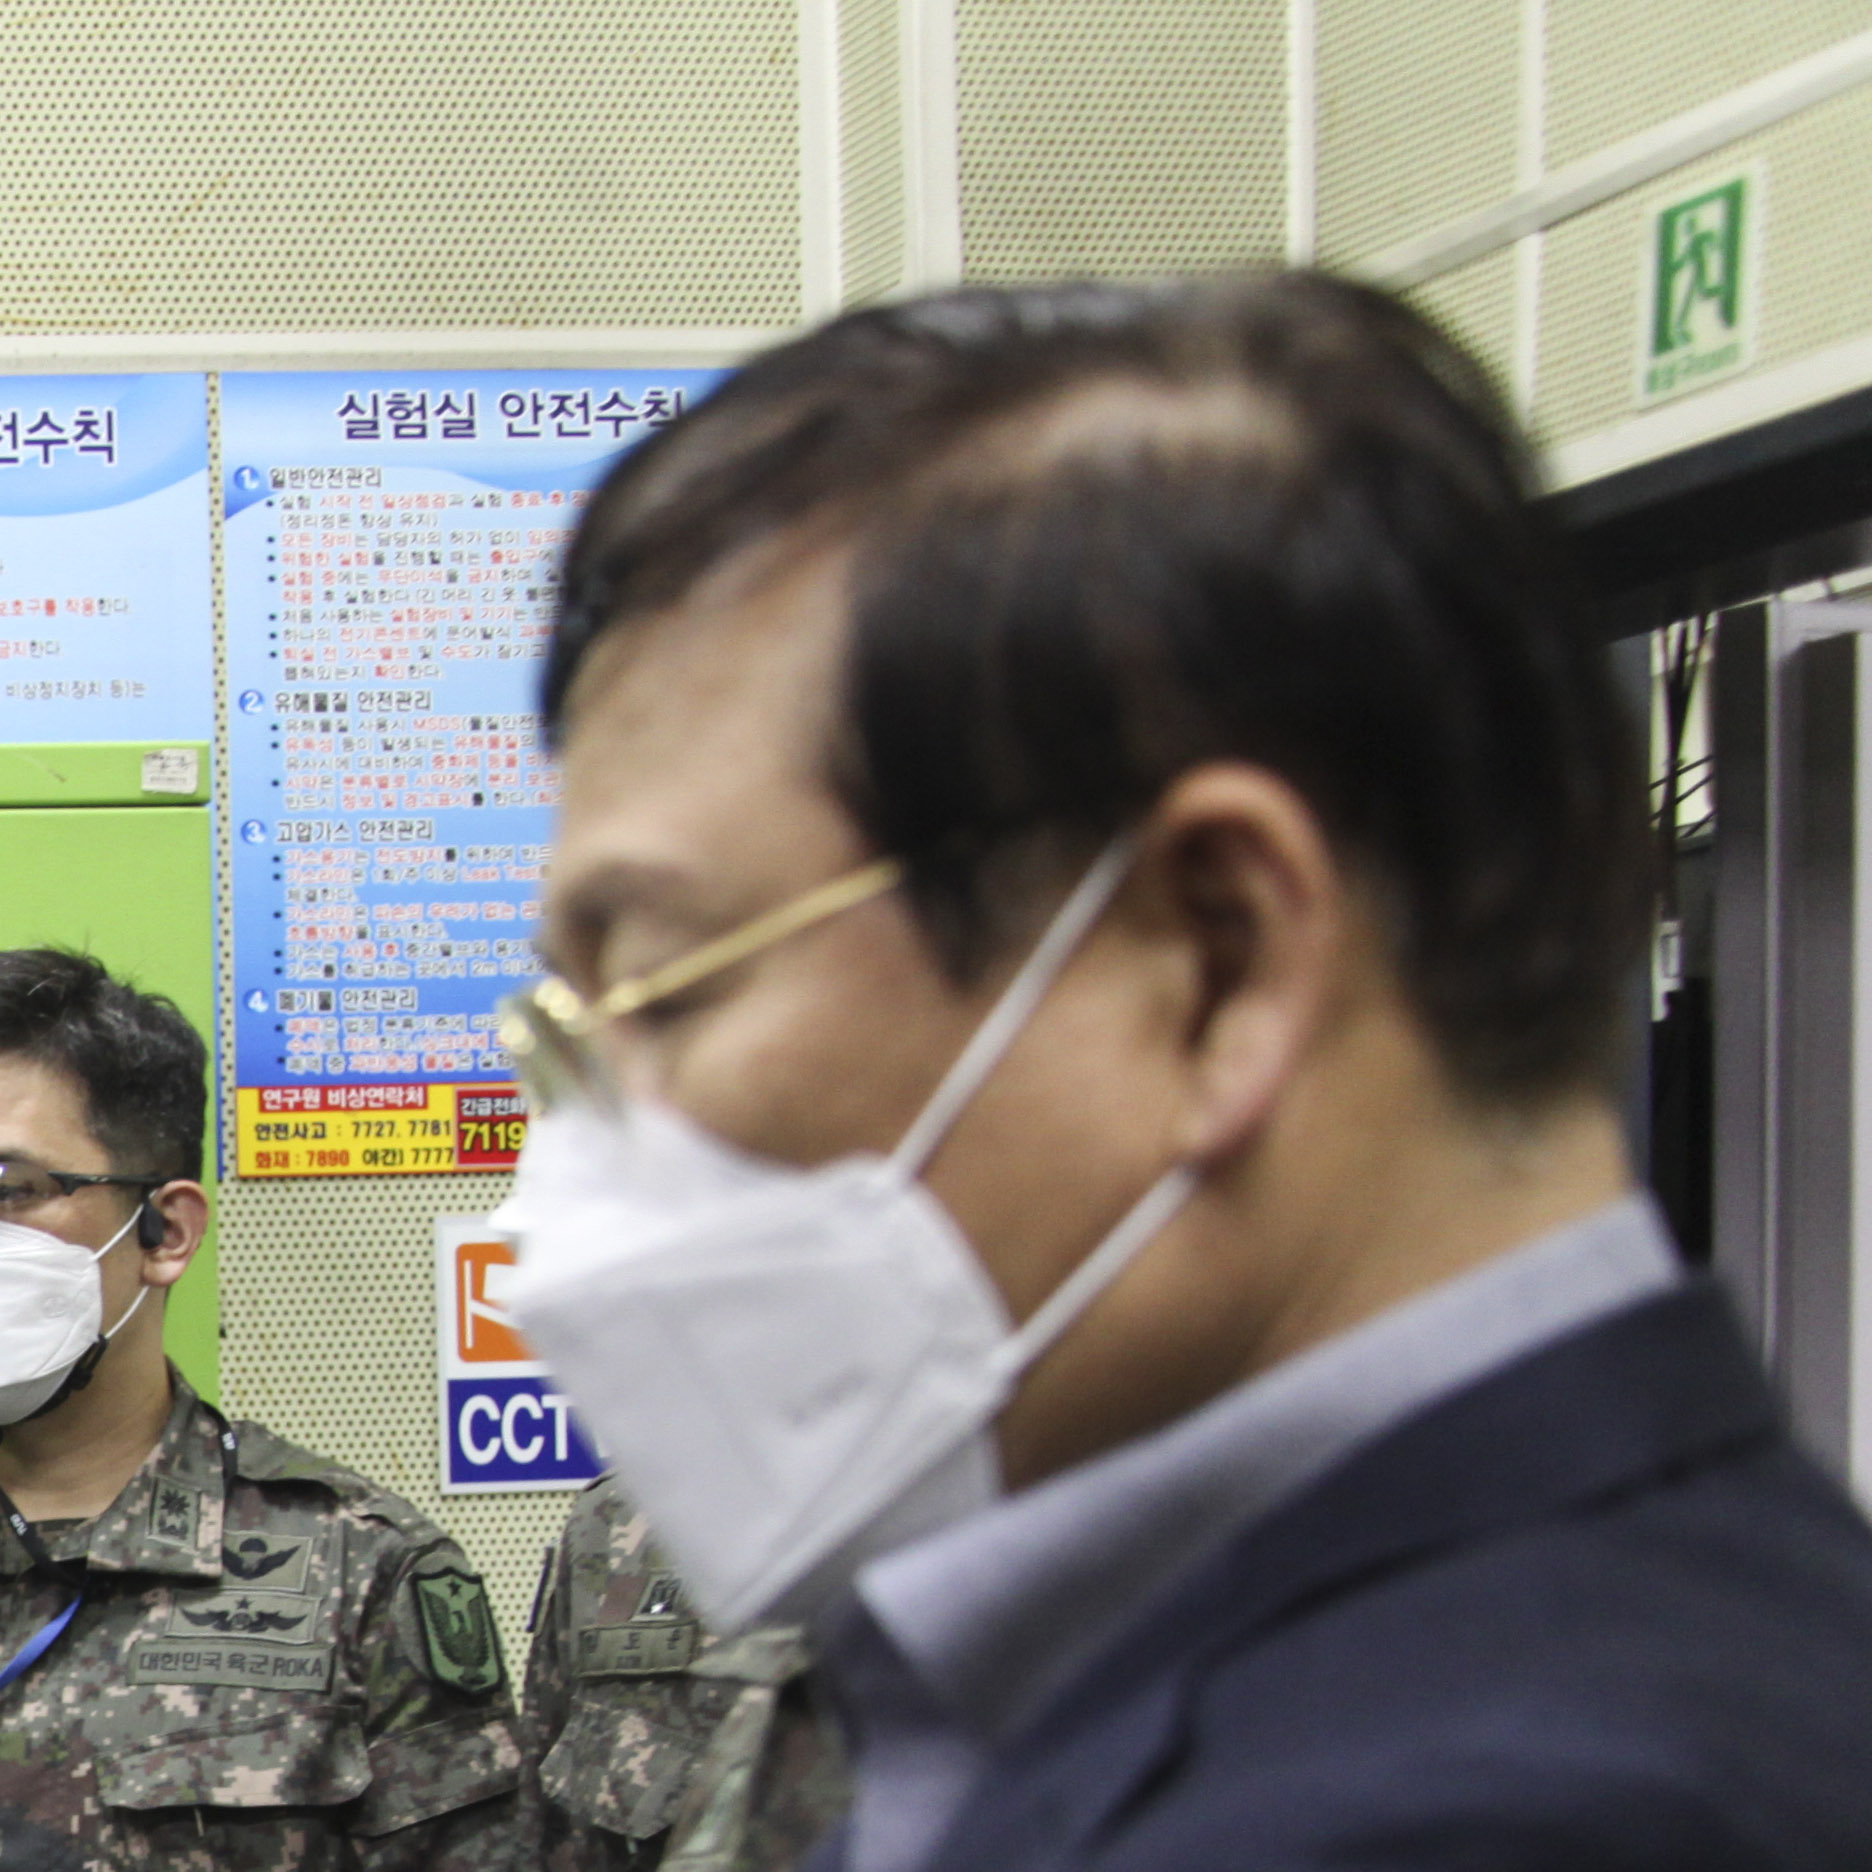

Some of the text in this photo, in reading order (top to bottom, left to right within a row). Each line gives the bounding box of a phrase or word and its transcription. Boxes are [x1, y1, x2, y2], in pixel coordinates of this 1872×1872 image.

[336, 391, 478, 441] 실험실
[270, 467, 382, 489] 일반안전관리
[280, 494, 312, 510] 실험
[471, 493, 502, 509] 실험
[275, 690, 432, 714] 유해물질 안전관리
[276, 820, 434, 843] 고압가스 안전관리
[342, 988, 418, 1012] 안전관리
[262, 1085, 425, 1111] 연구원 비상연락처
[254, 1118, 451, 1142] 안전사고 7781
[458, 1121, 527, 1152] 7119
[254, 1147, 454, 1169] 화재 7890 7777
[459, 1393, 586, 1466] CCT
[138, 1651, 324, 1678] 대한민국 육군 ROKA
